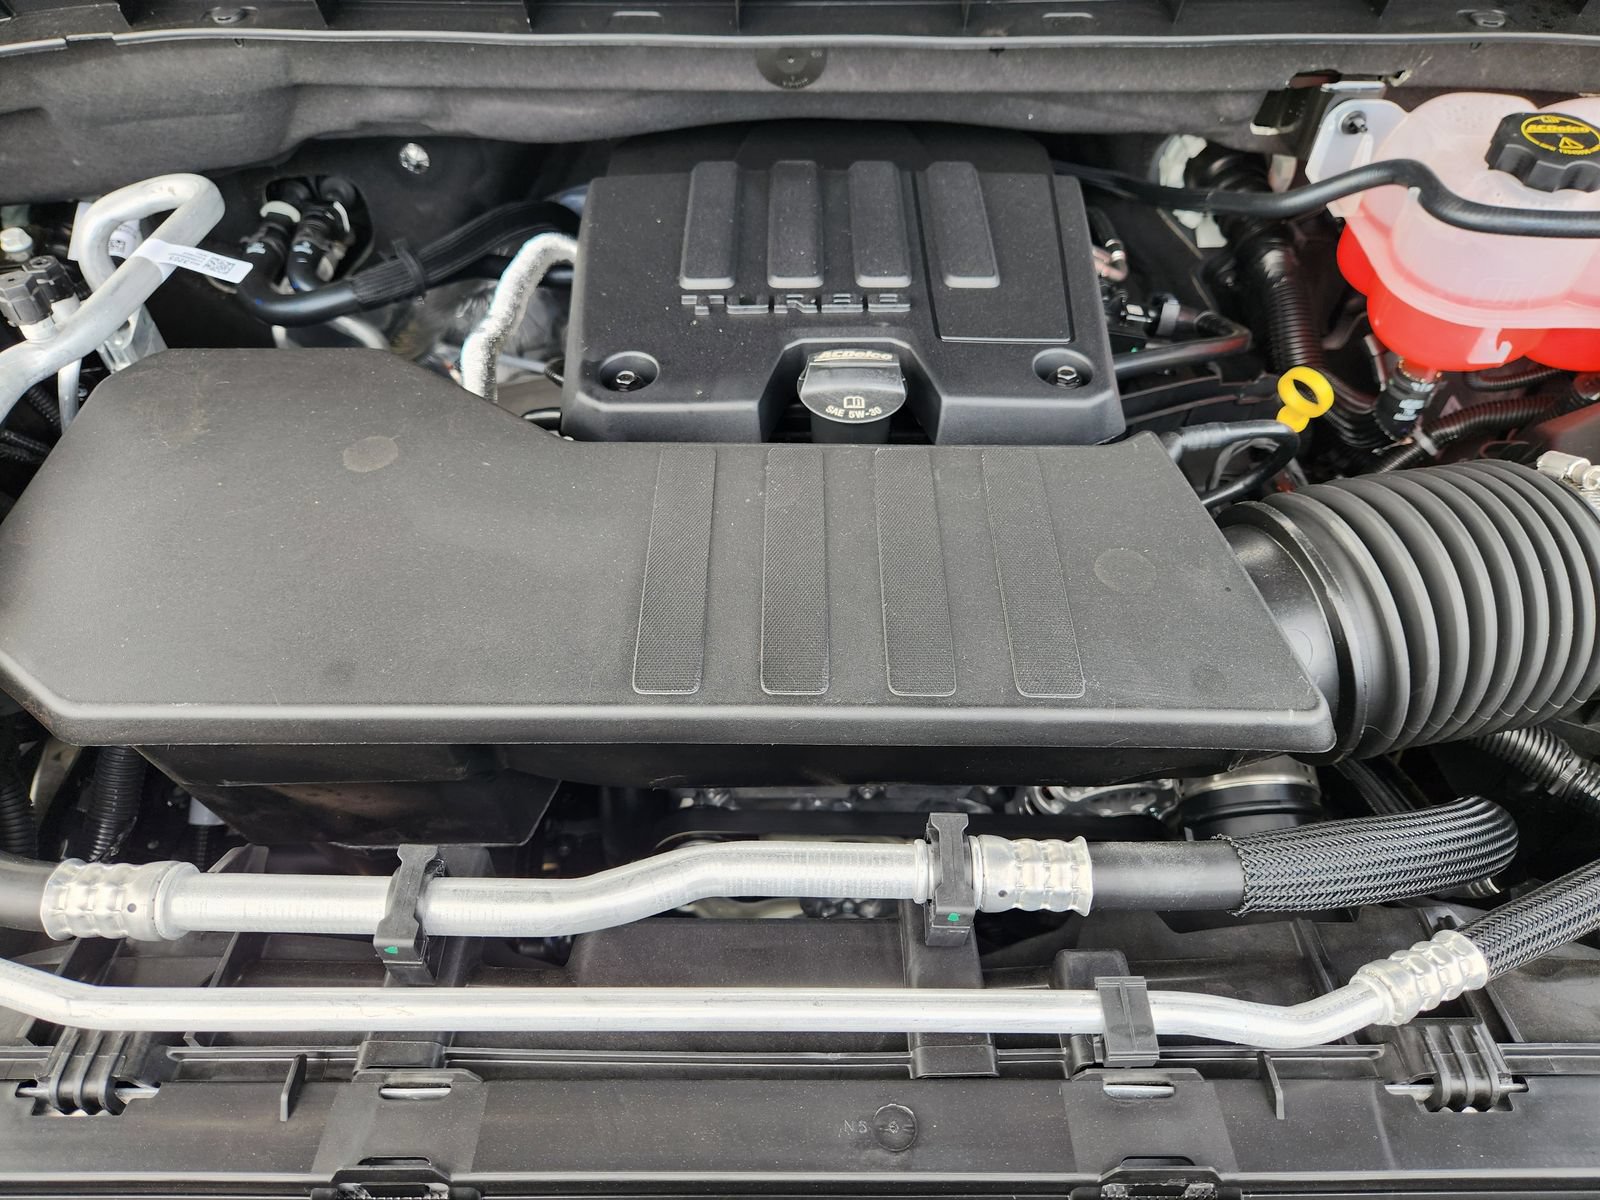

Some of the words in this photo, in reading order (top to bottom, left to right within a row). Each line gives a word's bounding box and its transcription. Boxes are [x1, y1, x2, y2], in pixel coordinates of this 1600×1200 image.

[814, 350, 893, 362] ACDelco
[825, 405, 845, 418] SAE
[848, 406, 883, 419] 5W-30
